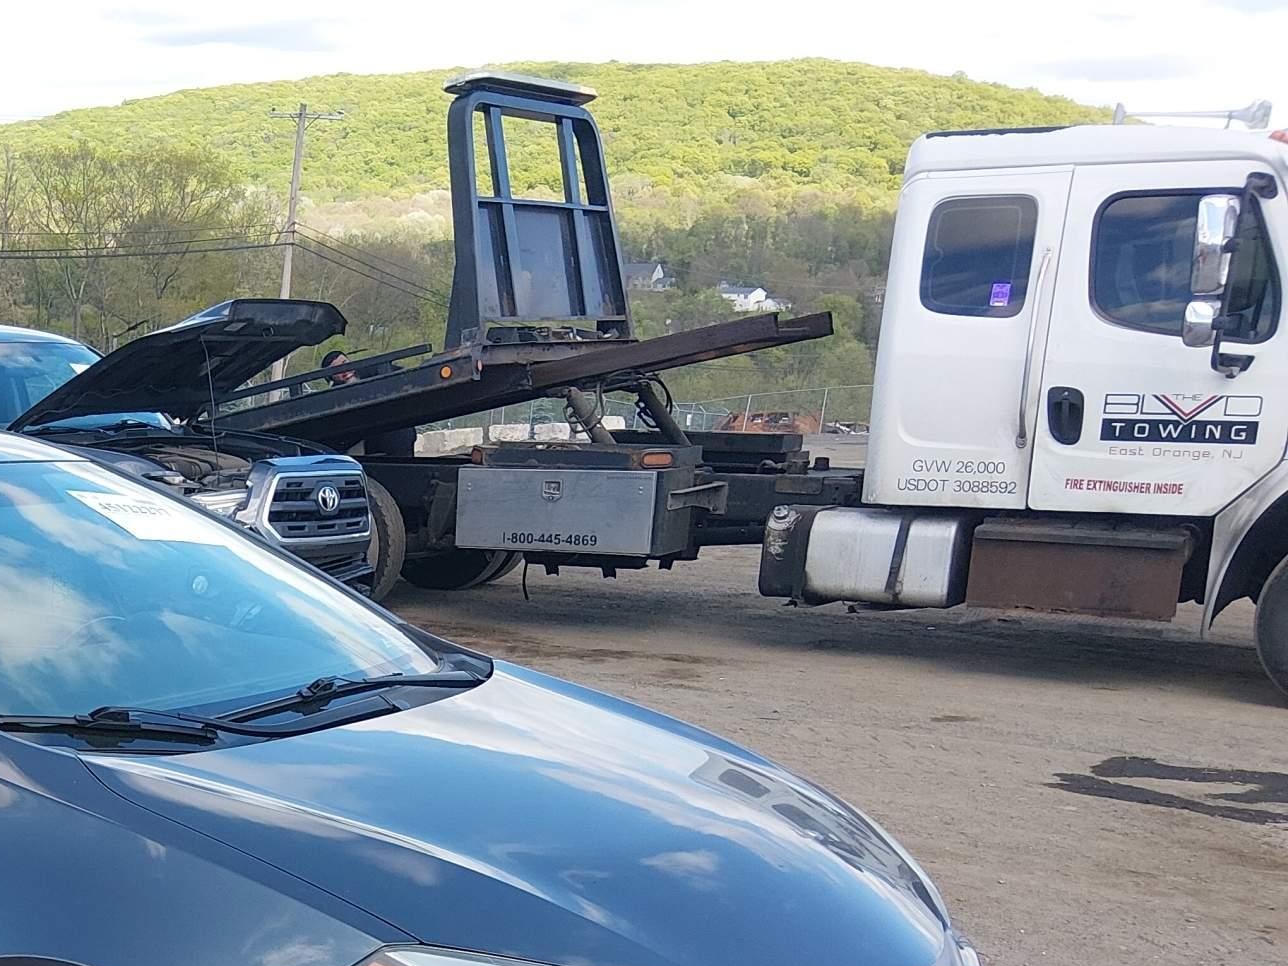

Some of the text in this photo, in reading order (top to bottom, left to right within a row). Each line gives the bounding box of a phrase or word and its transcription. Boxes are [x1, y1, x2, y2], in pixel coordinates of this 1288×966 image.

[1173, 393, 1203, 401] THE
[1103, 393, 1263, 423] BLVD
[1112, 422, 1248, 440] TOWING
[1108, 446, 1244, 461] East Orange, NJ
[912, 459, 1006, 475] GVW 26,000
[897, 478, 1017, 494] USDOT 3088592
[1064, 478, 1184, 495] FIRE EXTINGUISHER INSIDE
